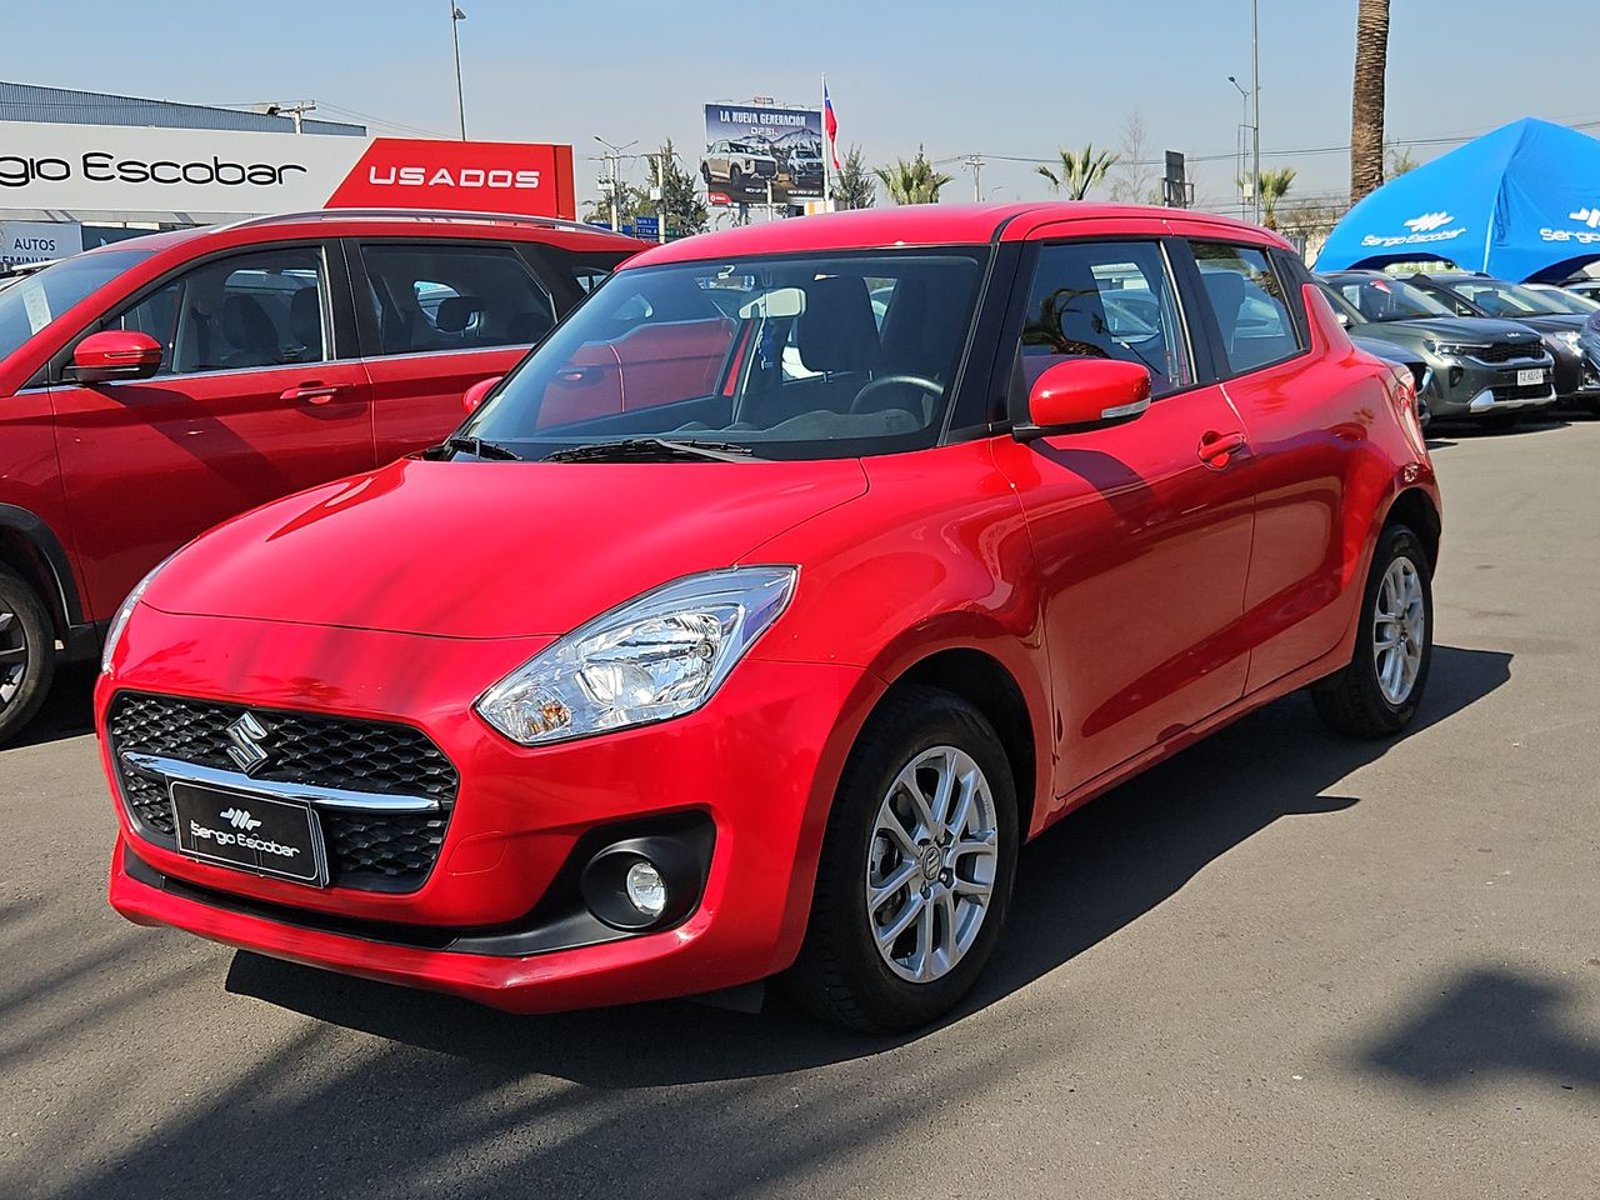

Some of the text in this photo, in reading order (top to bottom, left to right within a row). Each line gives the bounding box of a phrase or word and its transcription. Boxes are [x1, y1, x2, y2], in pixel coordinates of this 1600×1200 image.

[720, 110, 730, 122] LA
[732, 111, 758, 124] NUEVA
[82, 152, 307, 186] Escobar
[369, 166, 541, 188] USADOS
[14, 238, 56, 251] AUTOS
[237, 833, 300, 858] Escobar
